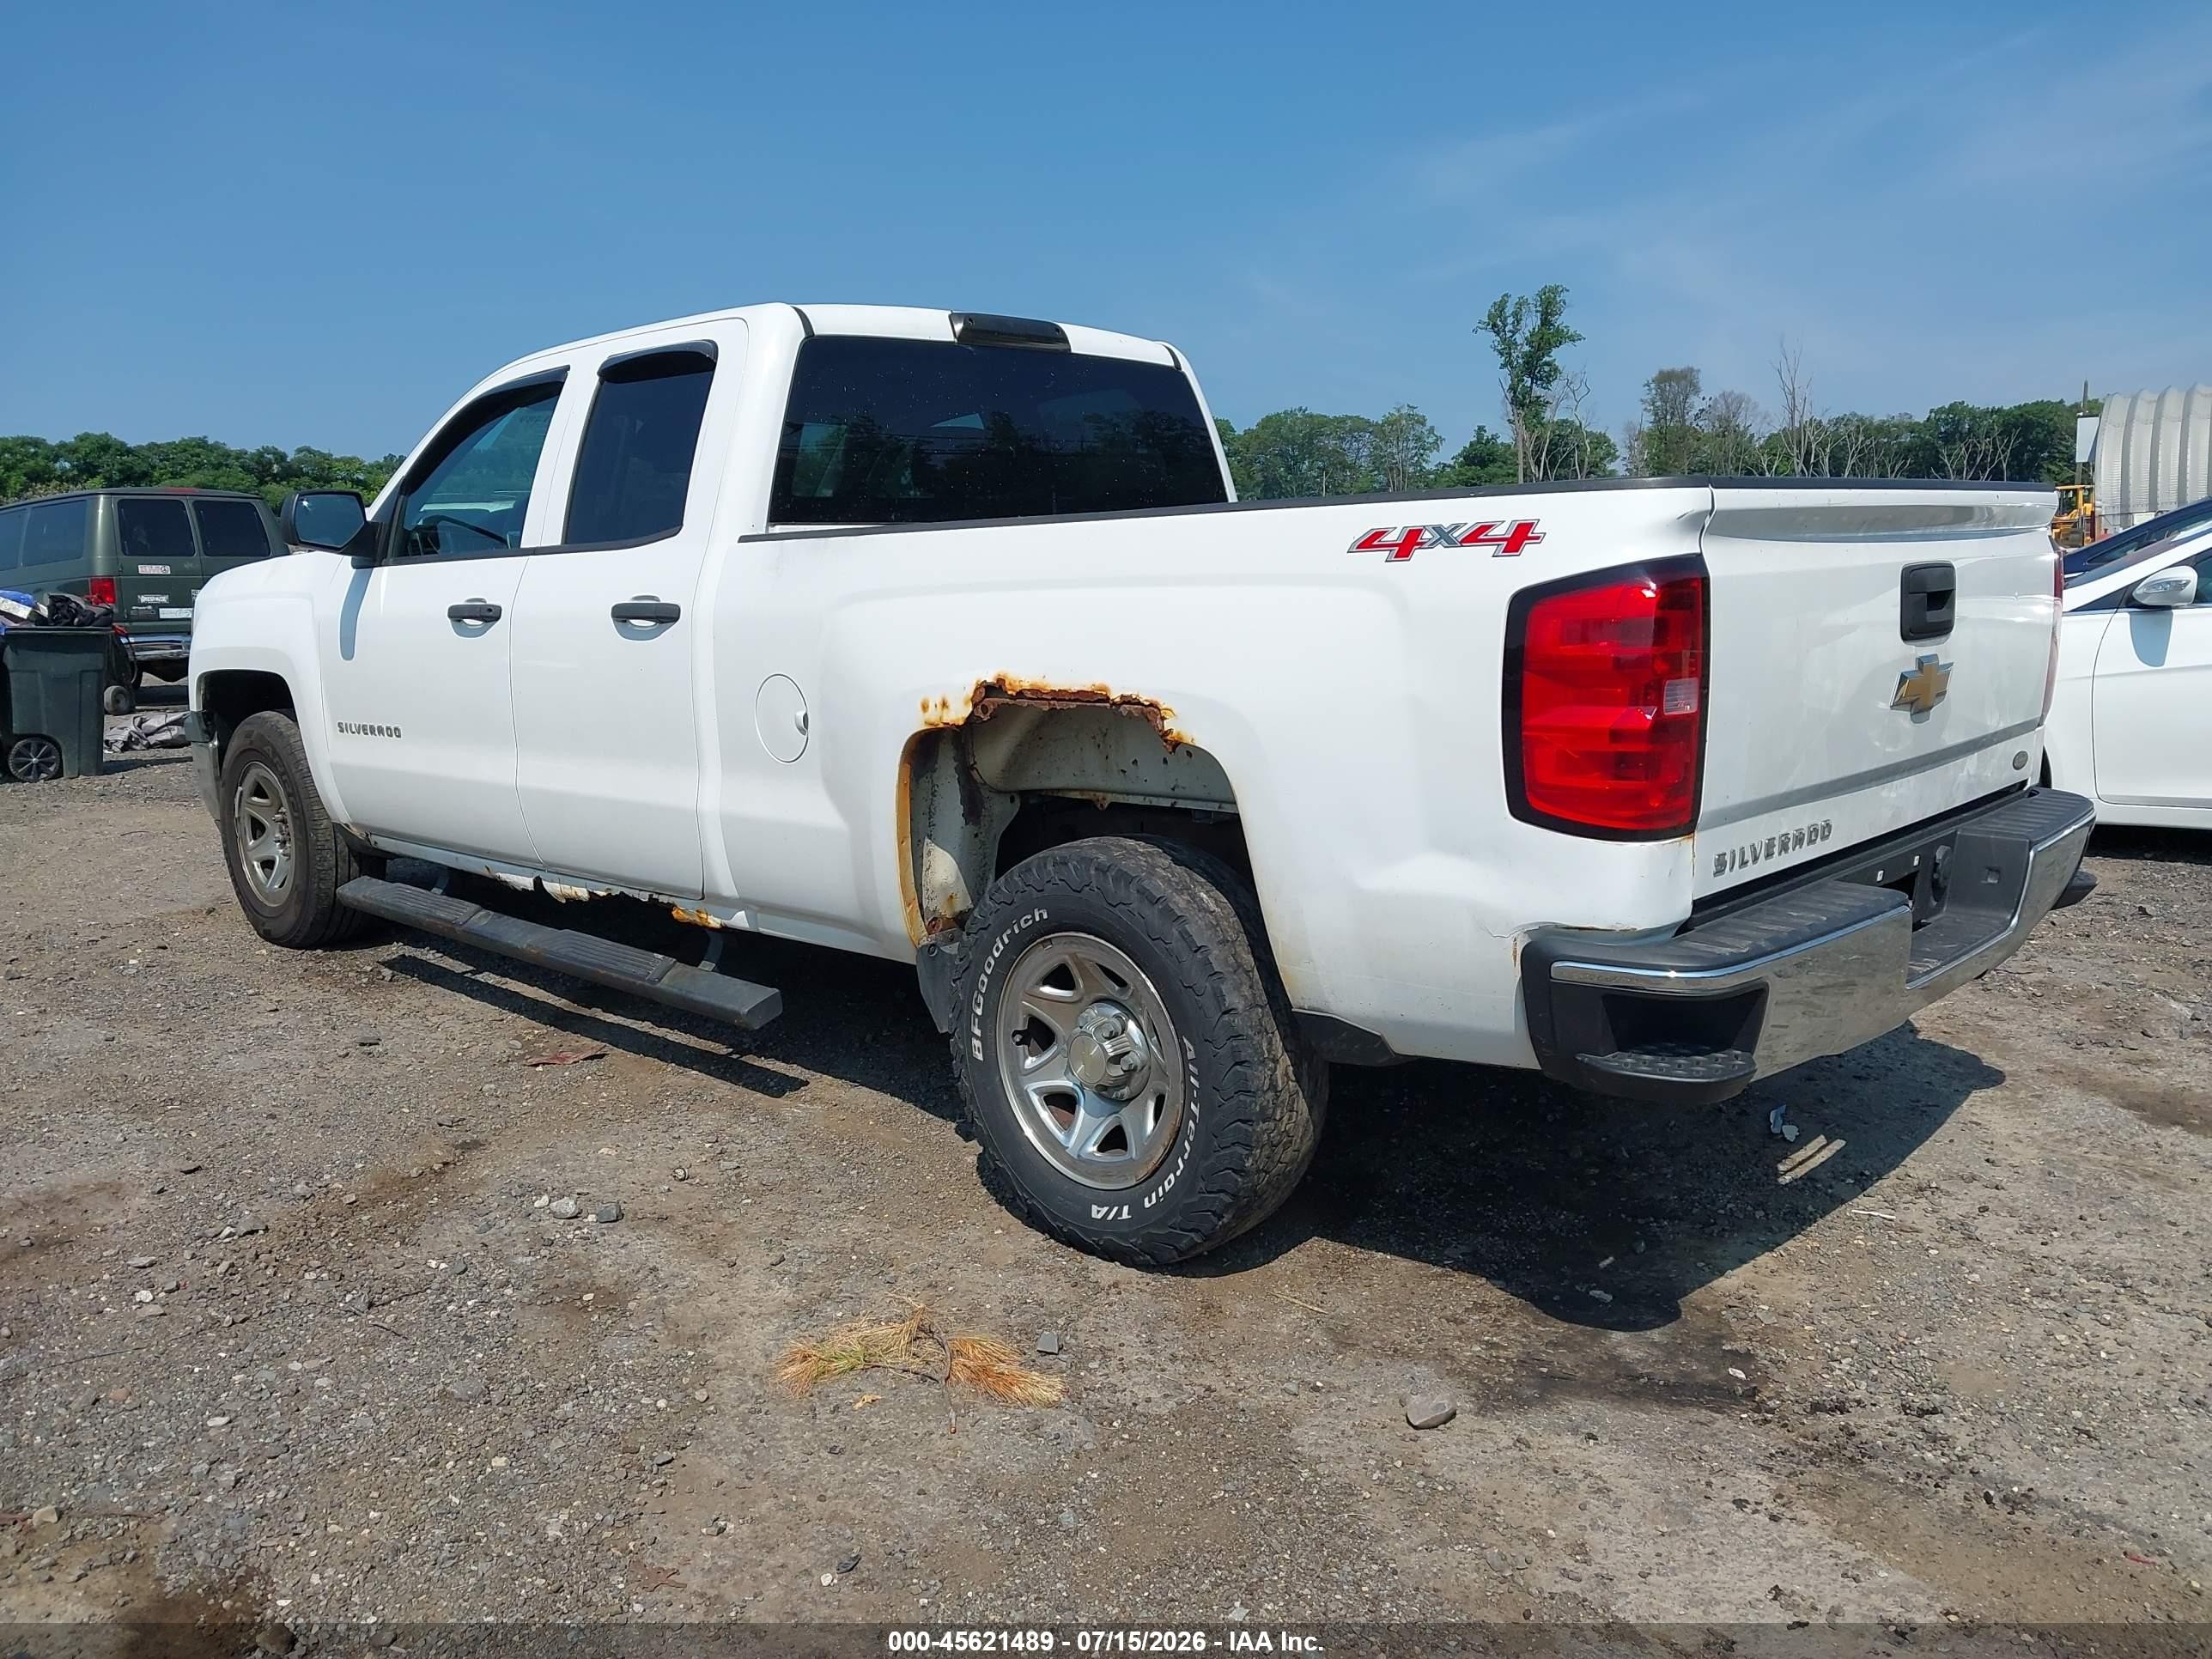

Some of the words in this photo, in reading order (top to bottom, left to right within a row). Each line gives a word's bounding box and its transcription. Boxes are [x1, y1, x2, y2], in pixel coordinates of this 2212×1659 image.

[337, 721, 402, 738] SILVERADO
[1712, 818, 1833, 878] SILVERADO
[971, 907, 1049, 1062] BFGoodrich
[1144, 1036, 1200, 1209] All-Terrain
[1091, 1196, 1133, 1221] T/A
